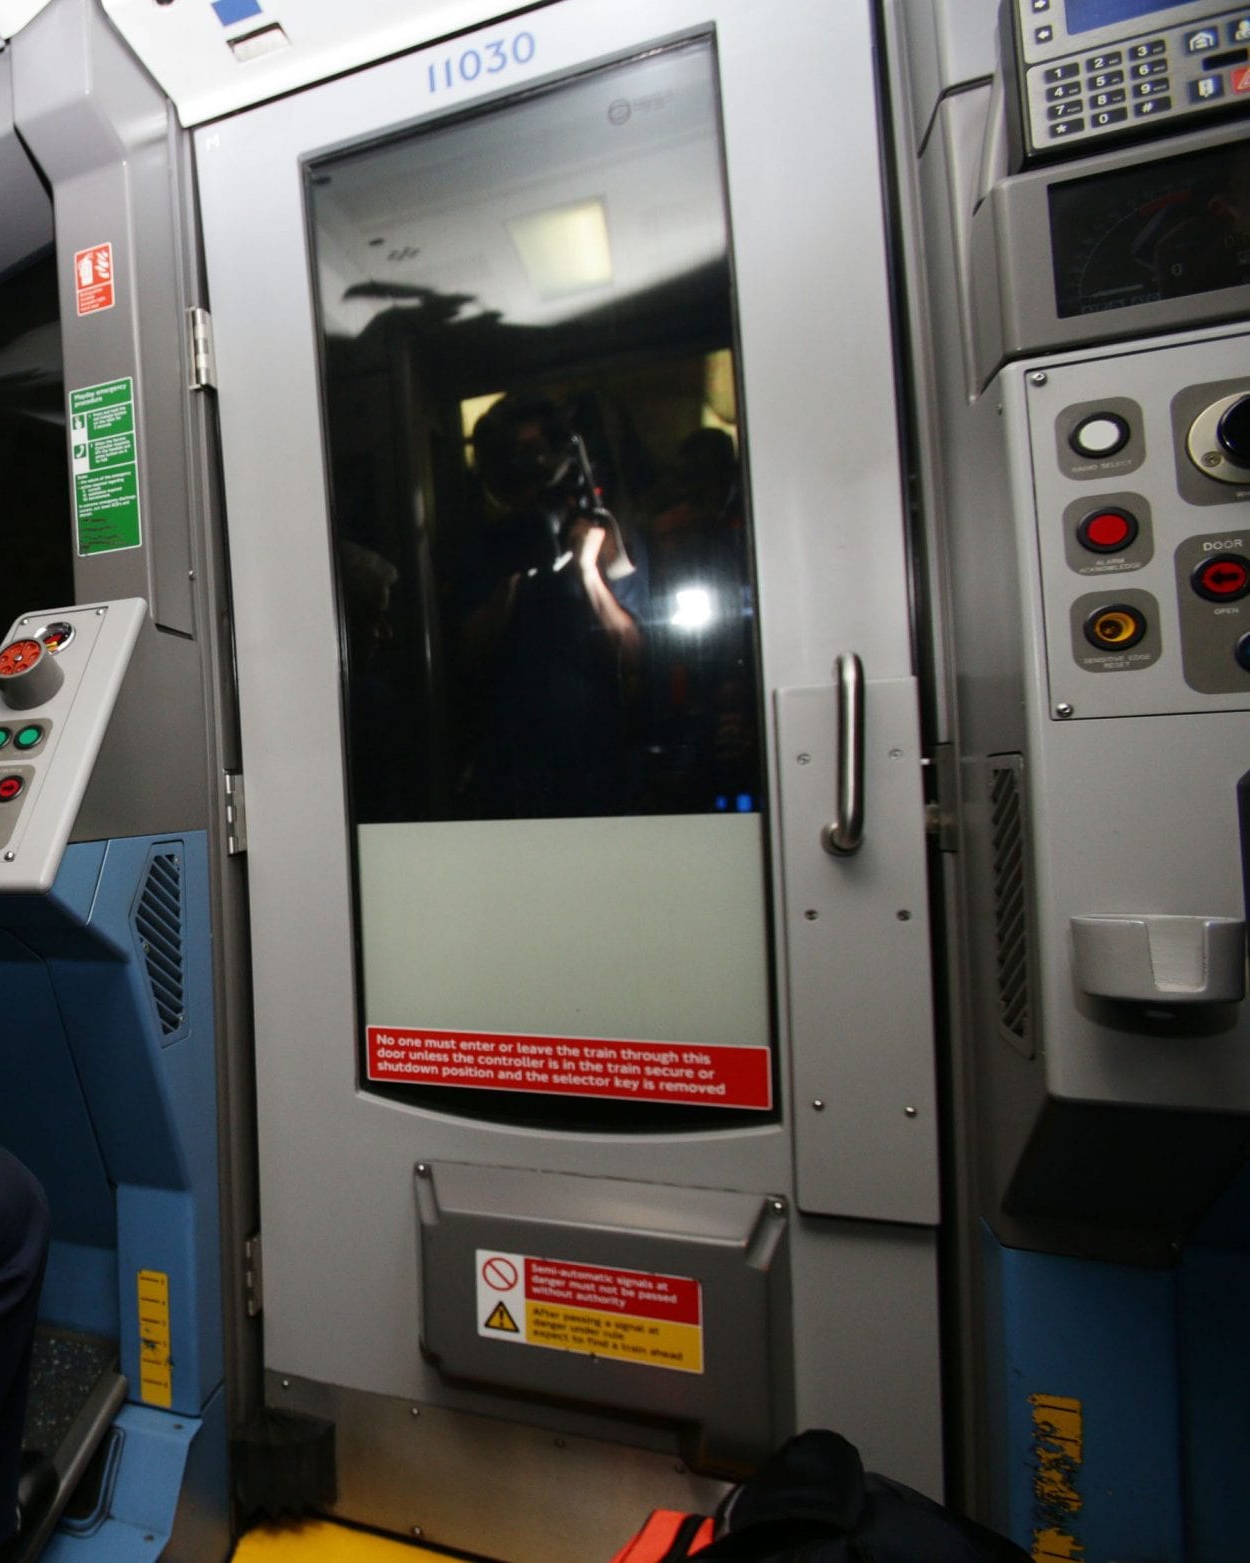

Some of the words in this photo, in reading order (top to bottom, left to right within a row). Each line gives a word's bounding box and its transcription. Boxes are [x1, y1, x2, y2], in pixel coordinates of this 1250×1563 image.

[1137, 46, 1148, 57] 3
[429, 31, 535, 92] 11030
[1094, 58, 1104, 68] 2
[1054, 69, 1062, 77] 1
[1139, 65, 1149, 75] 6
[1096, 76, 1106, 86] 5
[1054, 87, 1063, 97] 4
[1141, 84, 1150, 94] 9
[1097, 95, 1107, 105] 8
[1055, 105, 1065, 115] 7
[1099, 113, 1108, 124] 0
[96, 384, 127, 395] emergency
[1071, 464, 1098, 473] RADIO
[1100, 460, 1132, 469] SELECT
[1203, 539, 1243, 551] DOOR
[1096, 558, 1125, 566] ALARM
[1079, 563, 1141, 573] ACKNOWLEDGE
[1213, 607, 1239, 615] OPEN
[376, 1033, 395, 1046] No
[398, 1038, 422, 1047] one
[425, 1038, 456, 1049] must
[460, 1041, 495, 1051] enter
[499, 1044, 514, 1053] or
[517, 1043, 553, 1055] leave
[556, 1045, 580, 1057] the
[584, 1047, 617, 1059] train
[621, 1049, 679, 1065] through
[683, 1052, 711, 1065] this
[377, 1047, 405, 1059] door
[409, 1050, 449, 1063] unless
[453, 1052, 474, 1064] the
[478, 1055, 545, 1069] controller
[548, 1058, 559, 1070] is
[563, 1058, 575, 1071] in
[579, 1060, 603, 1073] the
[607, 1061, 641, 1075] train
[644, 1066, 694, 1078] secure
[698, 1068, 715, 1079] or
[377, 1060, 438, 1075] shutdown
[442, 1065, 494, 1079] position
[499, 1068, 522, 1081] and
[526, 1070, 549, 1083] the
[552, 1073, 610, 1087] selector
[614, 1077, 639, 1091] key
[643, 1079, 655, 1090] is
[659, 1081, 726, 1096] removed
[531, 1263, 614, 1283] Semi-automatic
[617, 1274, 654, 1291] signals
[657, 1281, 669, 1291] at
[531, 1275, 566, 1290] danger
[568, 1280, 596, 1292] must
[600, 1284, 617, 1295] not
[621, 1285, 635, 1297] be
[637, 1289, 678, 1305] passed
[532, 1286, 573, 1300] without
[576, 1291, 626, 1308] authority
[533, 1307, 560, 1319] After
[563, 1313, 601, 1327] passing
[605, 1319, 611, 1327] a
[615, 1319, 645, 1334] signal
[649, 1326, 659, 1335] at
[533, 1318, 567, 1332] danger
[570, 1323, 599, 1335] under
[603, 1328, 624, 1340] rule
[533, 1329, 569, 1343] expect
[572, 1335, 585, 1344] to
[588, 1335, 609, 1348] find
[622, 1341, 646, 1354] train
[651, 1347, 683, 1361] ahead
